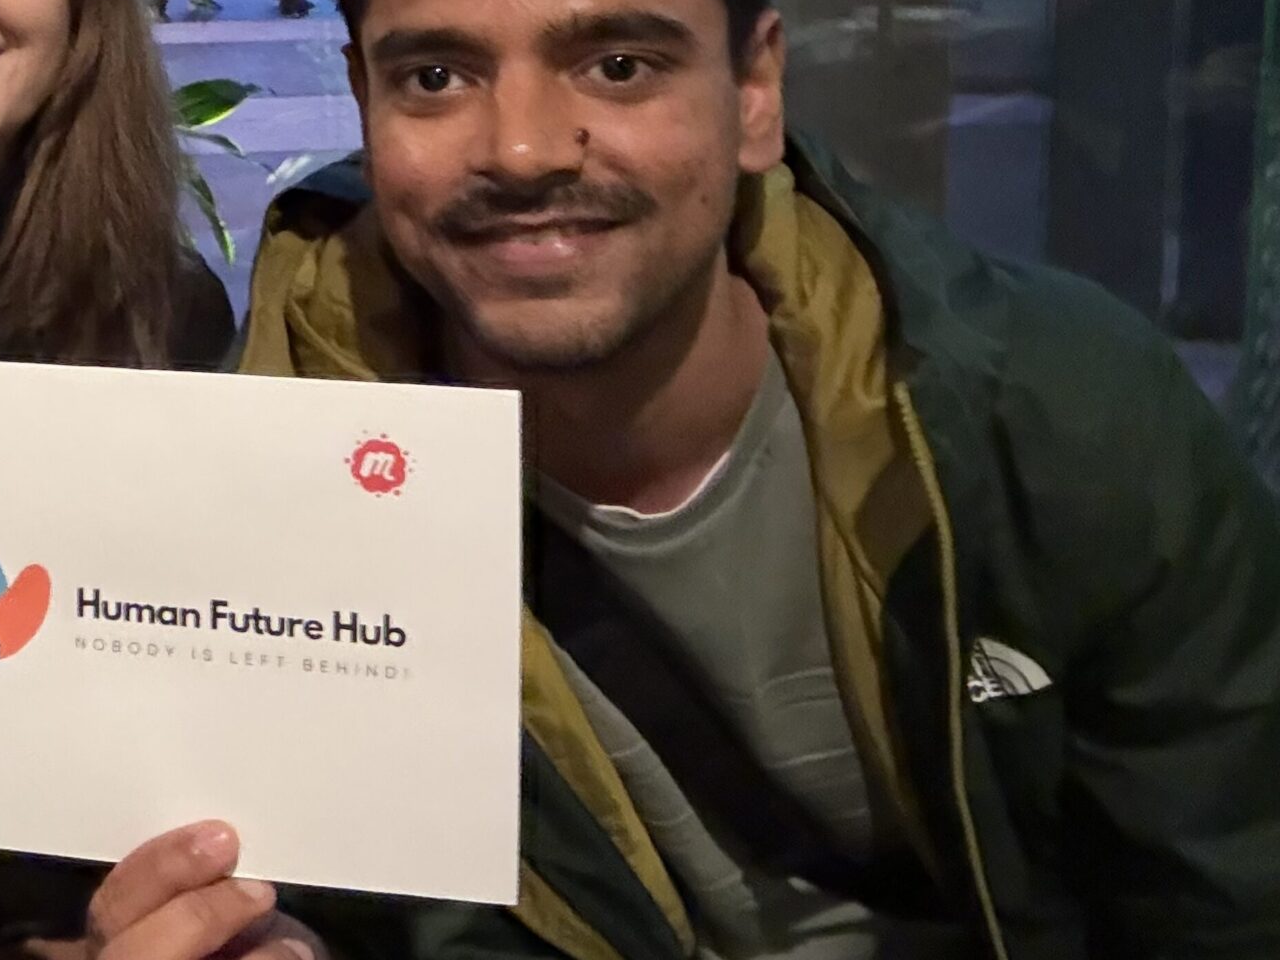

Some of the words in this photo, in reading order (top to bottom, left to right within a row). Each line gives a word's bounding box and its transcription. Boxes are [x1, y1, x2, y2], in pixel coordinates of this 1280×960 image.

[76, 587, 201, 628] Human
[209, 598, 324, 640] Future
[332, 609, 406, 648] Hub
[75, 637, 175, 657] NOBODY
[191, 648, 213, 662] IS
[229, 650, 286, 669] LEFT
